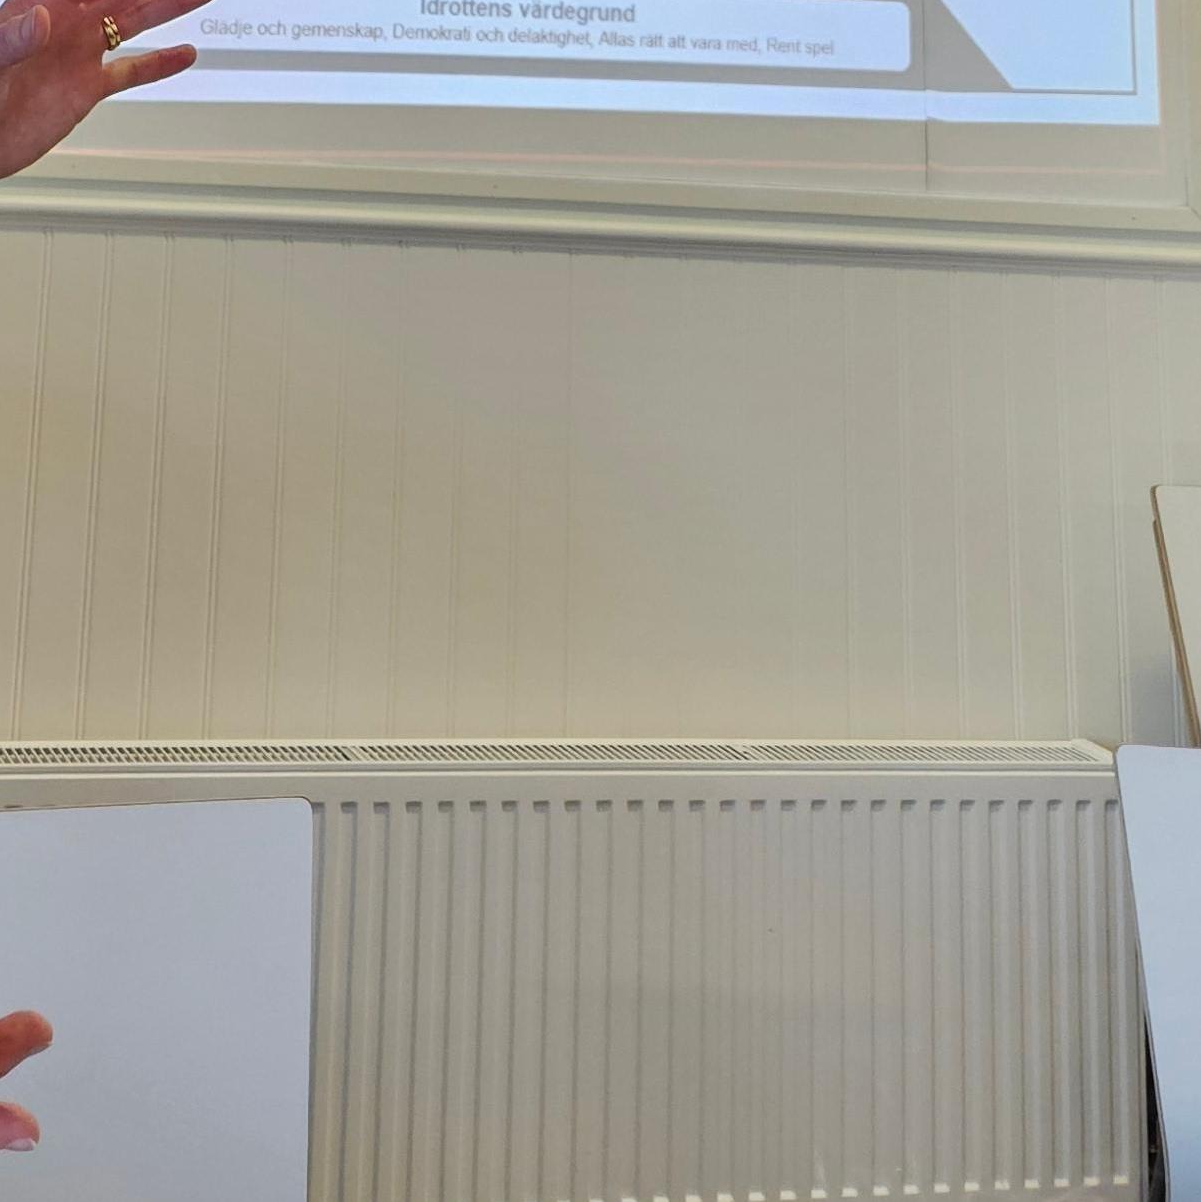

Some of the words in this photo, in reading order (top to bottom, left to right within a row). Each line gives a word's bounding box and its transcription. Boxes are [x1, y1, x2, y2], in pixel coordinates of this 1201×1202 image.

[519, 1, 636, 26] värdegrund
[200, 18, 253, 39] Glädje
[257, 22, 287, 37] och
[291, 22, 388, 42] gemenskap,
[393, 23, 471, 42] Demokrati
[476, 26, 504, 43] och
[508, 27, 593, 48] delaktighet,
[599, 30, 635, 47] Allas
[640, 33, 663, 48] rätt
[668, 34, 687, 49] att
[690, 37, 721, 50] vara
[726, 37, 761, 53] med,
[766, 37, 802, 54] Rent
[805, 39, 835, 58] spel
